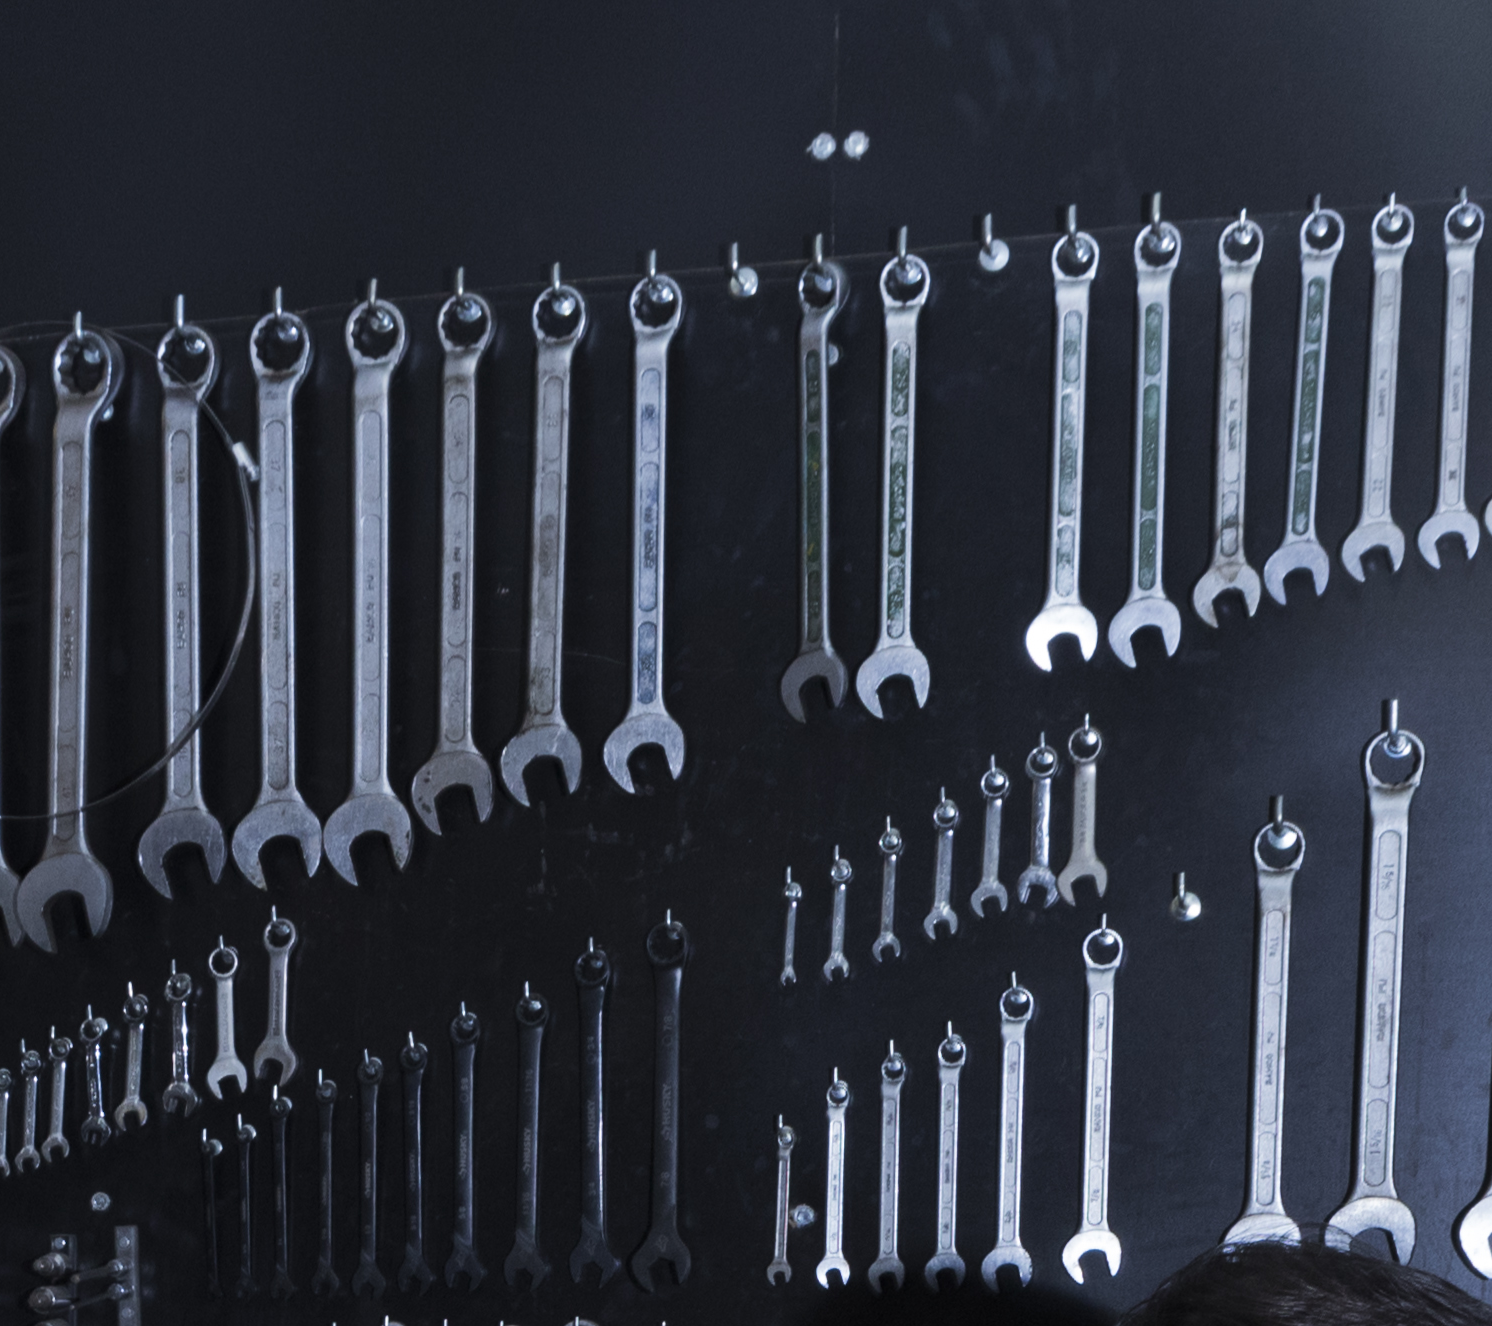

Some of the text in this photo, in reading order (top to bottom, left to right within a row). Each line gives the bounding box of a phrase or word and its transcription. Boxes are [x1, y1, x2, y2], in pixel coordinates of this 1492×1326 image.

[586, 1099, 596, 1138] HUSKY
[661, 1083, 672, 1125] HUSKY
[458, 1133, 467, 1167] HUSKY
[523, 1127, 532, 1163] HUSKY
